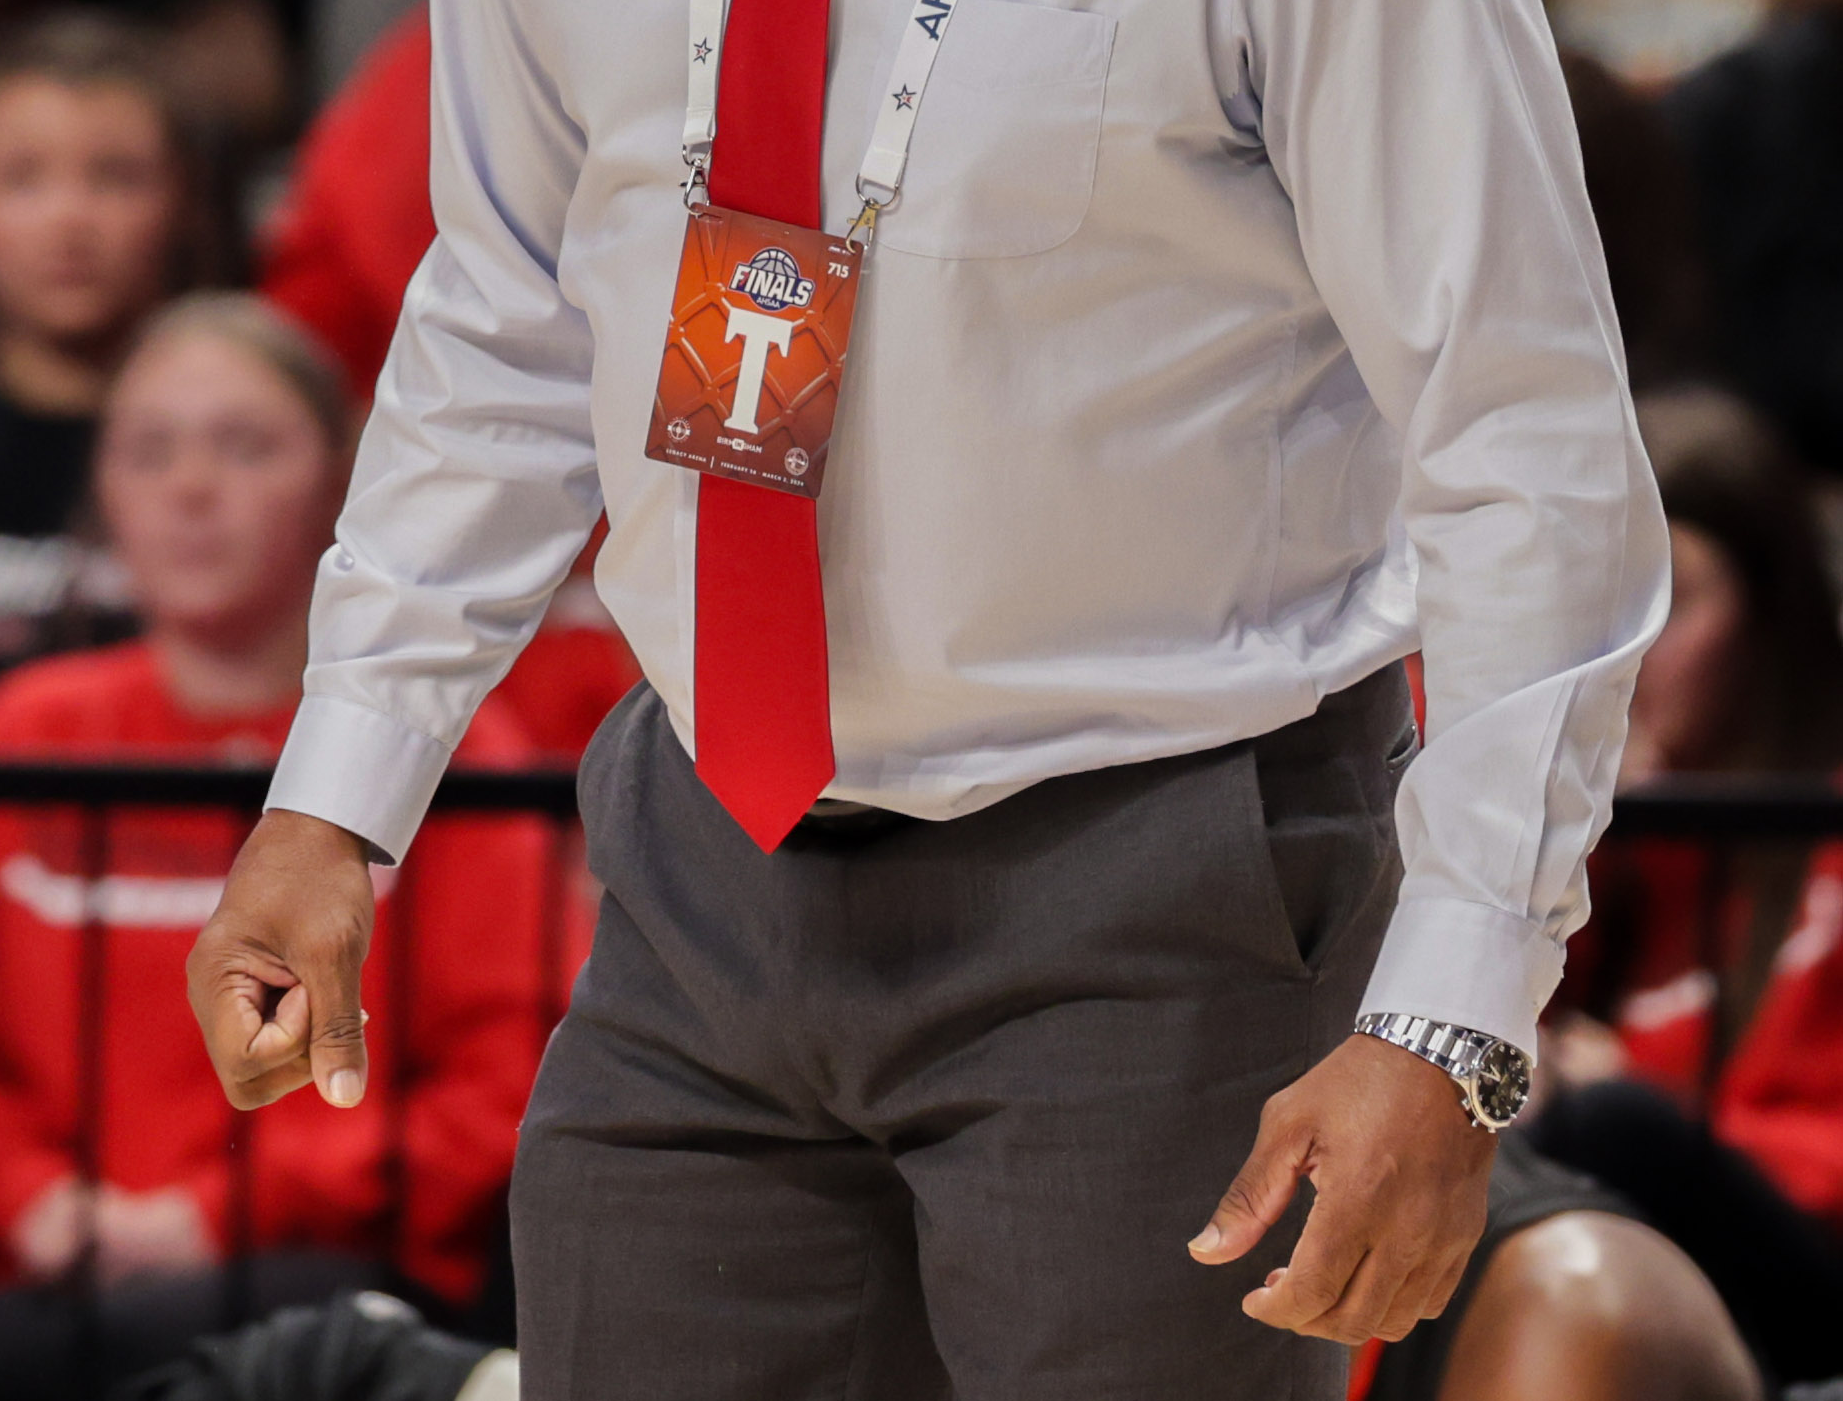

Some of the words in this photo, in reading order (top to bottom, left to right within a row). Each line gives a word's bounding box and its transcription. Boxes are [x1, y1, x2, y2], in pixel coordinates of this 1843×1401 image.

[730, 264, 814, 306] FINALS
[827, 261, 850, 279] 715
[756, 296, 781, 309] AHSAA
[723, 307, 794, 435] T
